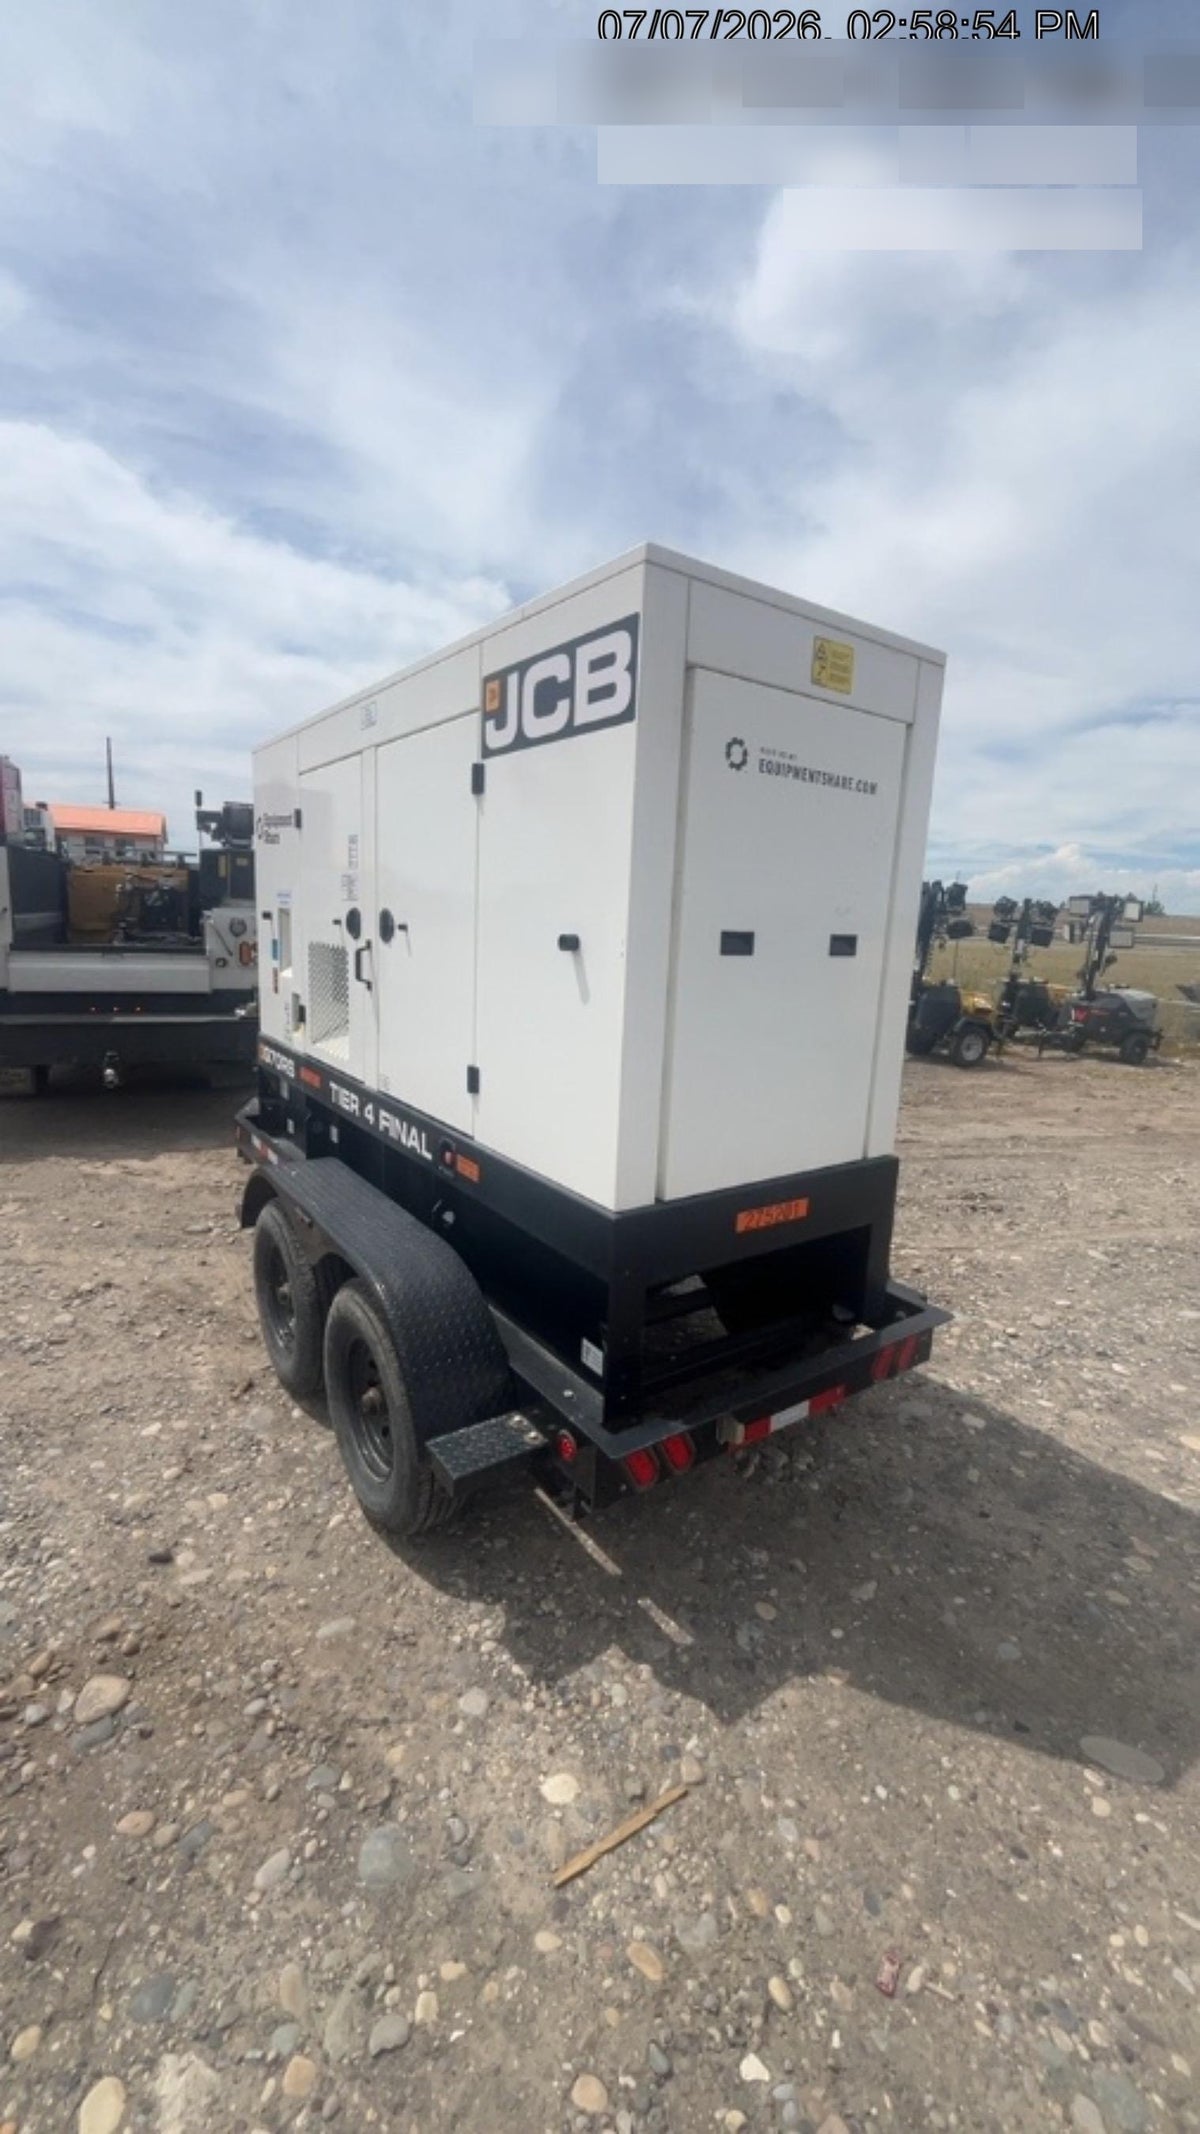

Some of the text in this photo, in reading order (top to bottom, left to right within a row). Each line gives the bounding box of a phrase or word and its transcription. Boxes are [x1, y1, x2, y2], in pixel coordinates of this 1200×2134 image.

[486, 629, 632, 750] JCB
[758, 758, 878, 795] EQUIPMENTSHARE.COM
[329, 1080, 433, 1161] TIER 4 FINAL
